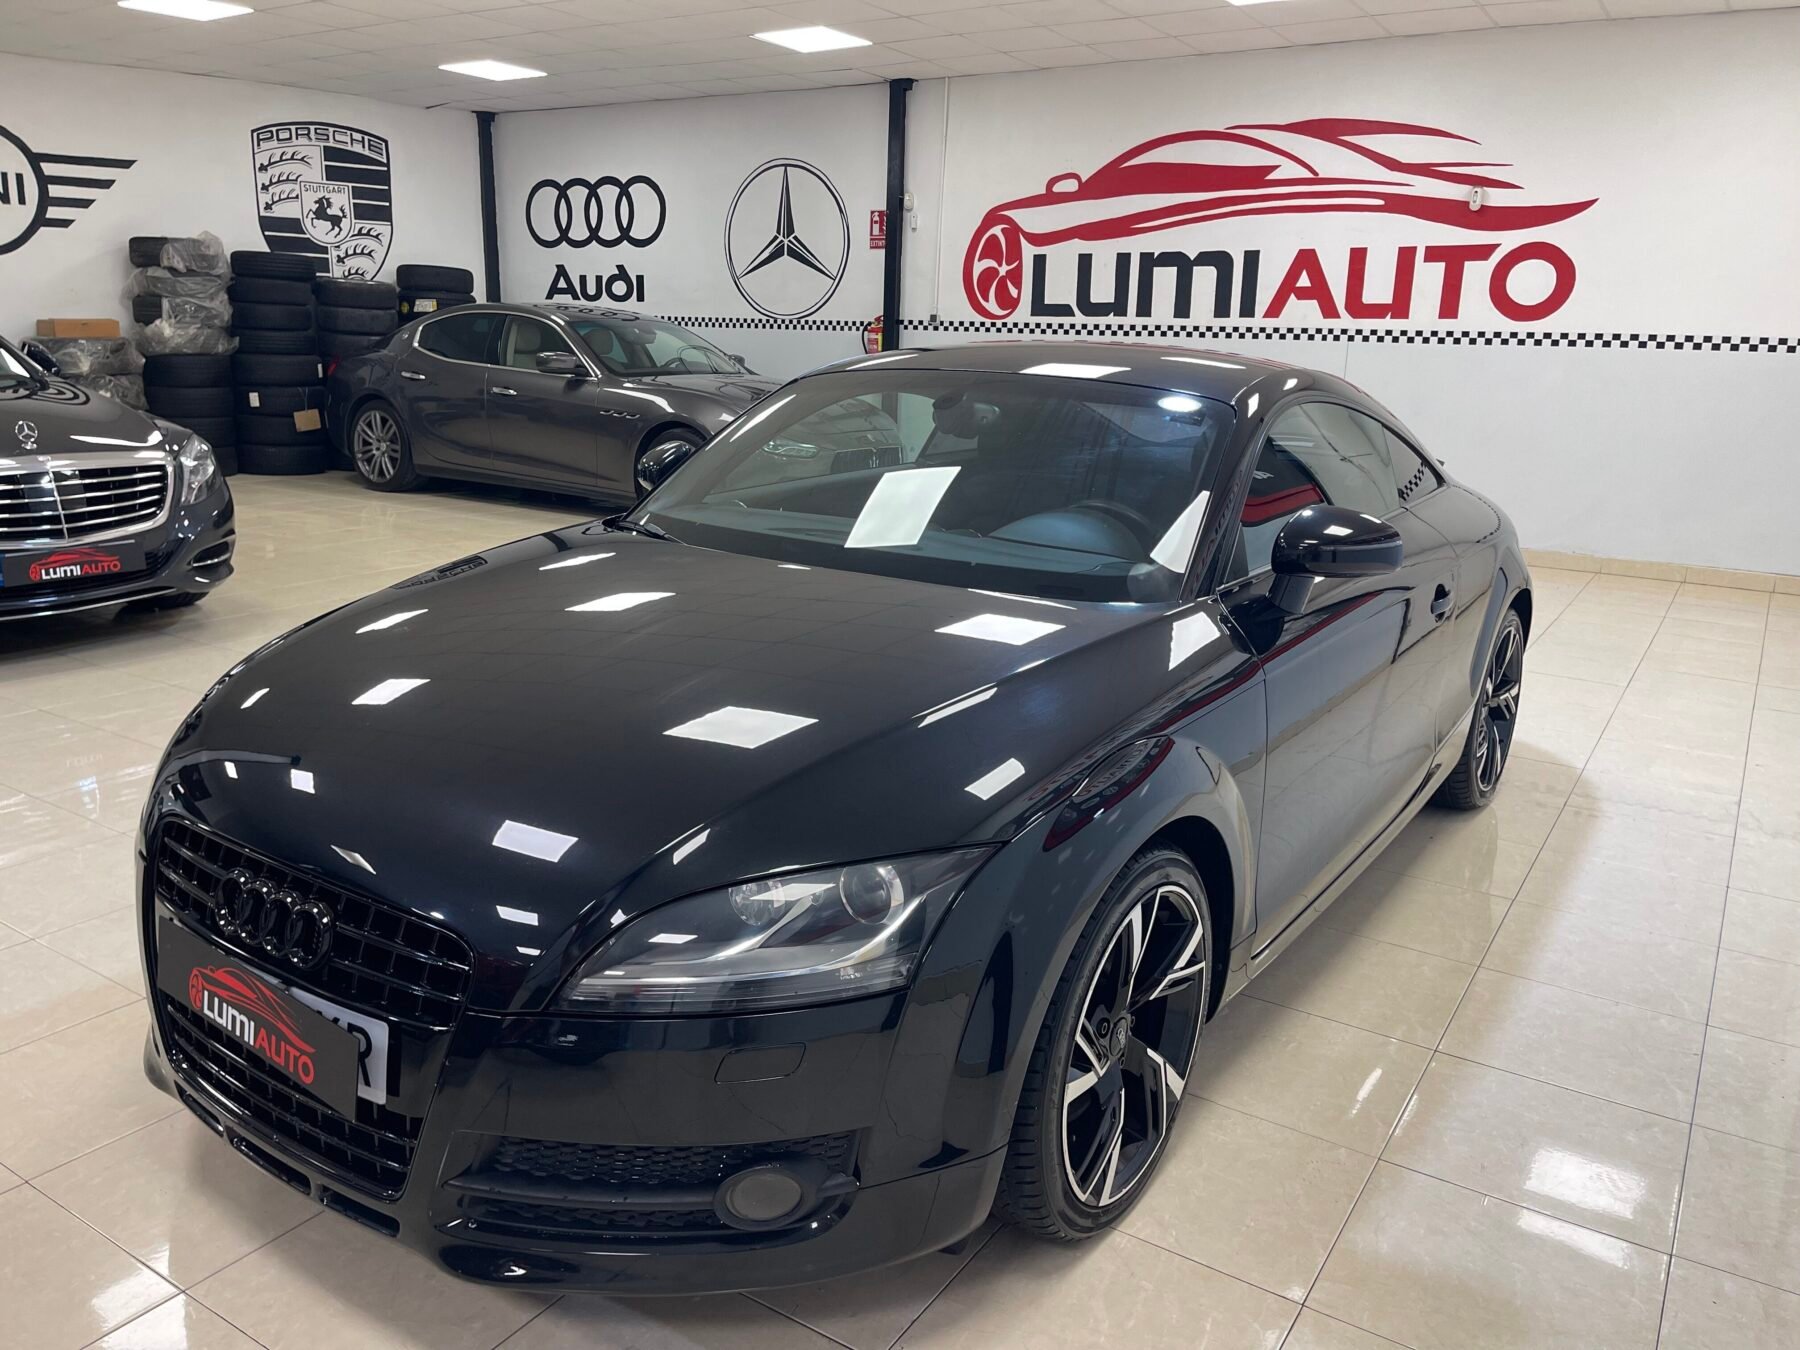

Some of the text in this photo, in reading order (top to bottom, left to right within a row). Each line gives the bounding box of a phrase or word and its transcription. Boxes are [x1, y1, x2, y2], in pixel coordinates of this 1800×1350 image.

[256, 126, 385, 160] PORSCHE
[303, 184, 346, 195] STUTTGART
[544, 263, 645, 302] Audi
